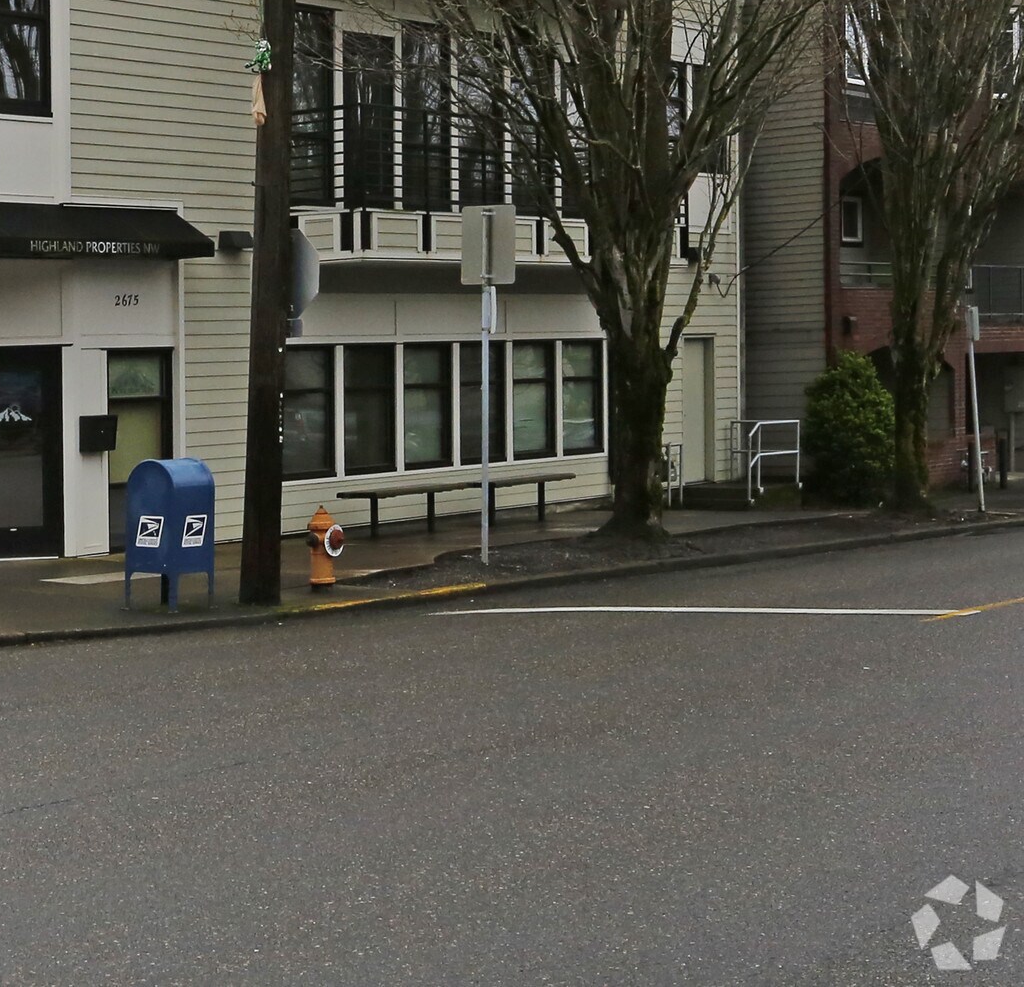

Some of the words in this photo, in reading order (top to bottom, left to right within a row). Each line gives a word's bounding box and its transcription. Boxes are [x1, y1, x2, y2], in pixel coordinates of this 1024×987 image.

[30, 240, 83, 253] HIGHLAND
[85, 241, 141, 254] PROPERTIES
[143, 242, 160, 254] NW
[114, 293, 139, 307] 2675
